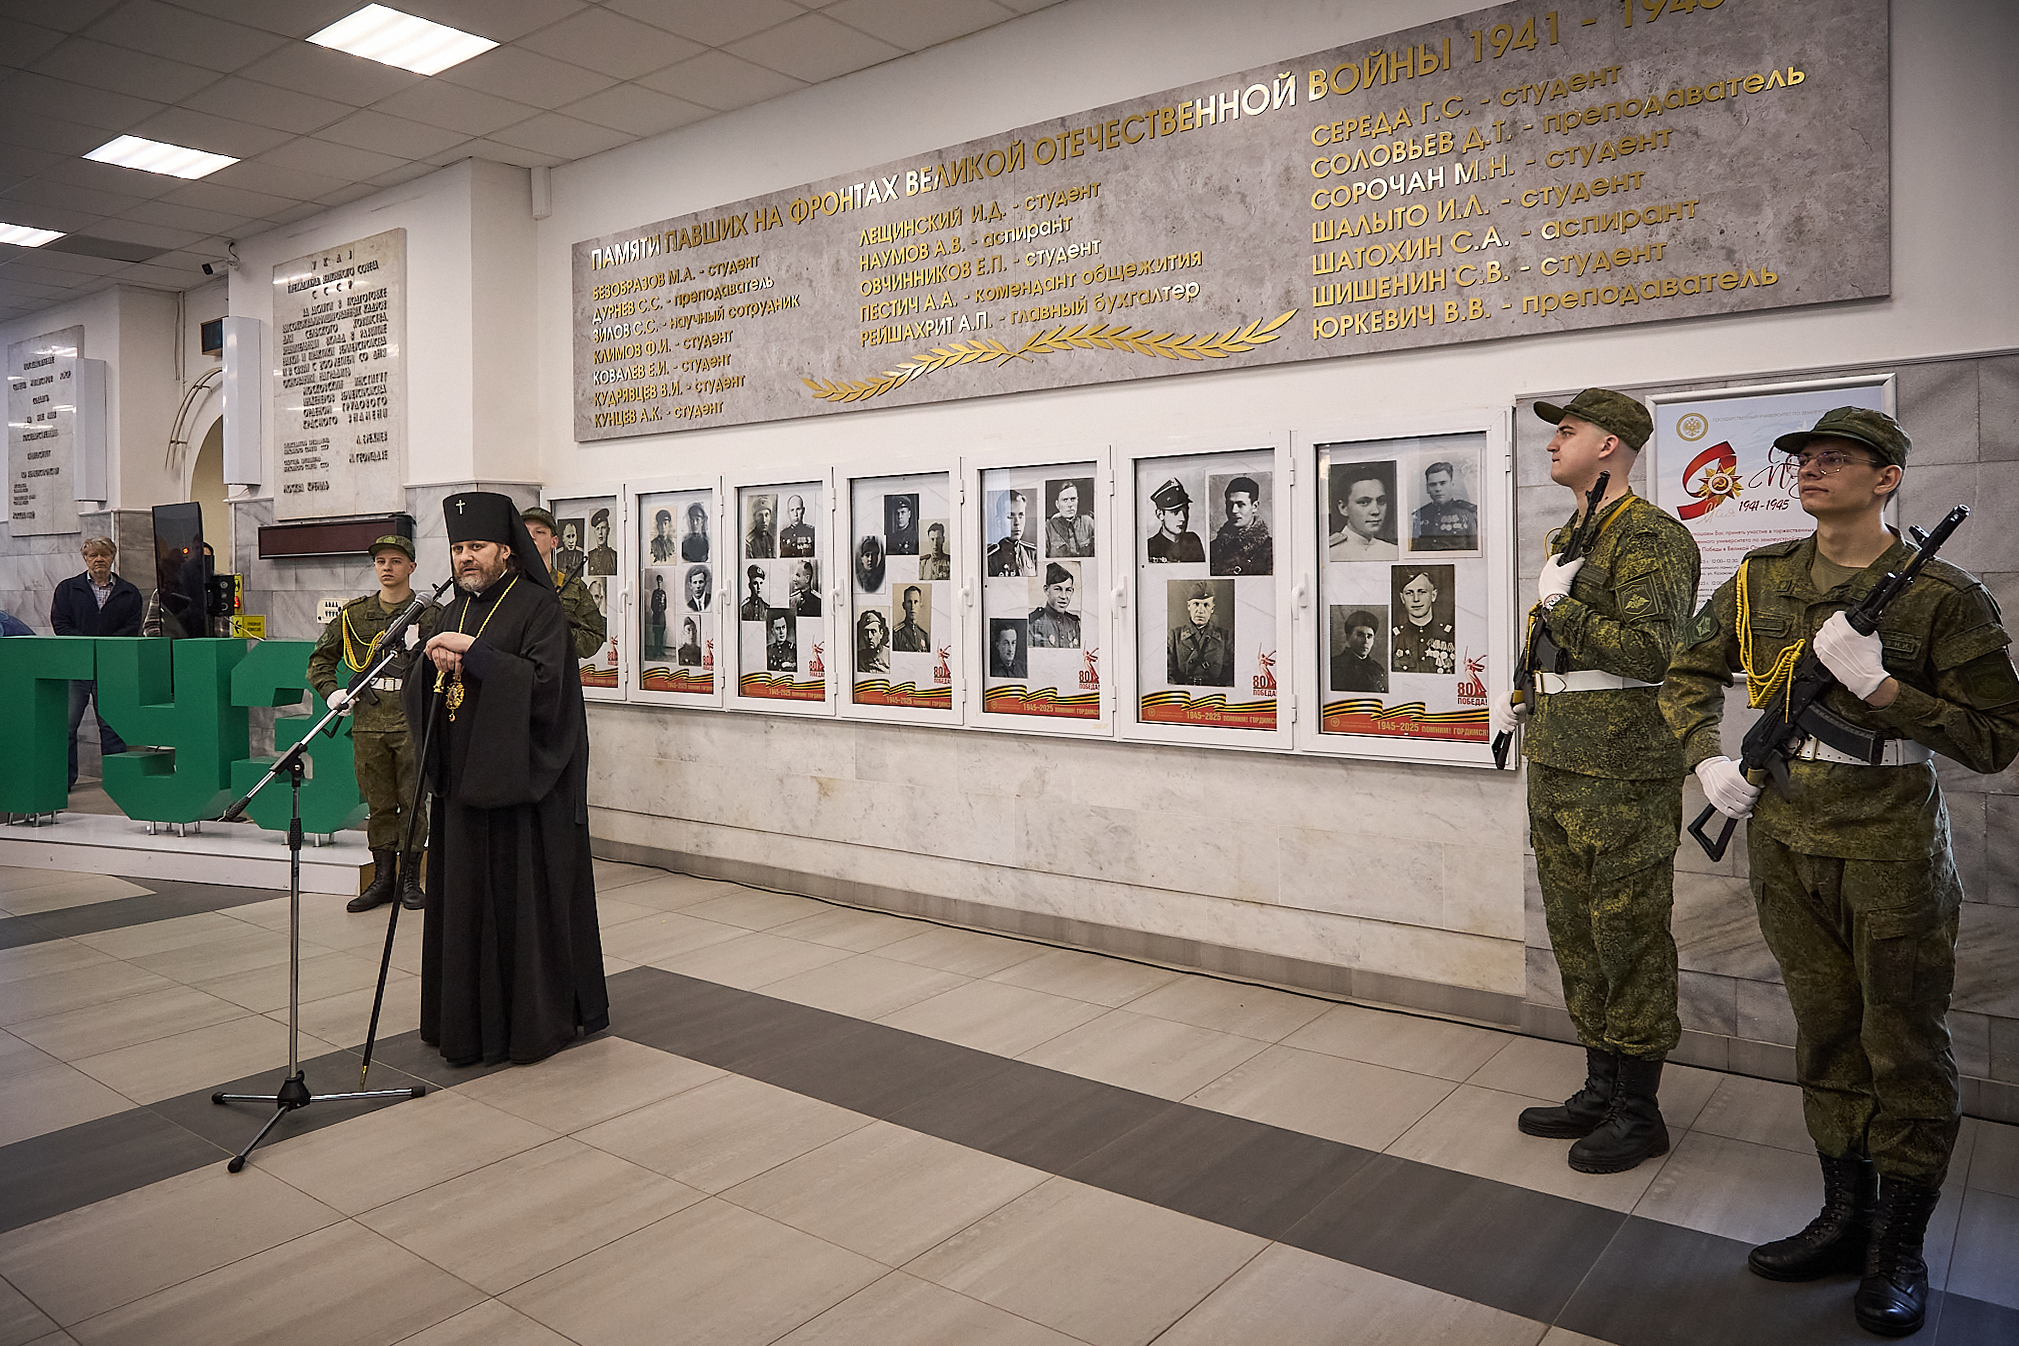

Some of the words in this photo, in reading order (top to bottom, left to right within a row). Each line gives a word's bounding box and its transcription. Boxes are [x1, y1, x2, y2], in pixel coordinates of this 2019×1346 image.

[1311, 111, 1412, 147] СЕРЕДА
[1421, 96, 1471, 124] Г.С.
[1500, 65, 1621, 107] студент
[1311, 131, 1454, 179] СОЛОВЬЕВ
[1544, 67, 1805, 135] преподаватель
[591, 234, 661, 270] ПАМЯТИ
[665, 213, 748, 253] ПАВШИХ
[753, 206, 783, 233] НА
[788, 175, 899, 225] ФРОНТАХ
[905, 139, 1026, 196] ВЕЛИКОЙ
[1032, 71, 1297, 166] ОТЕЧЕСТВЕННОЙ
[1308, 38, 1451, 102] ВОЙНЫ
[1470, 11, 1559, 63] 1941
[1311, 166, 1444, 211] СОРОЧАН
[1454, 154, 1514, 187] М.Н.
[1546, 129, 1673, 168] студент
[859, 206, 962, 247] ЛЕЩИНСКИЙ
[971, 202, 1006, 223] И.Д.
[1024, 182, 1101, 212] студент
[1312, 205, 1428, 244] ШАЛЫТО
[1438, 194, 1489, 222] И.Л.
[1520, 170, 1645, 208] студент
[860, 242, 929, 272] НАУМОВ
[934, 236, 965, 259] А.В.
[983, 214, 1073, 249] аспирант
[1312, 235, 1442, 276] ШАТОХИН
[1451, 226, 1510, 254] С.А.
[1541, 199, 1699, 240] аспирант
[592, 273, 665, 301] БЕЗОБРАЗОВ
[668, 267, 696, 286] М.А.
[708, 254, 760, 278] студент
[859, 263, 970, 296] ОВЧИННИКОВ
[976, 255, 1007, 276] Е.П.
[1025, 238, 1101, 267] студент
[860, 293, 919, 322] ПЕСТИЧ
[924, 289, 958, 311] А.А.
[975, 271, 1076, 303] комендант
[1081, 250, 1202, 287] общежития
[1312, 268, 1446, 308] ШИШЕНИН
[1456, 261, 1509, 288] С.В.
[1540, 242, 1667, 276] студент
[592, 301, 635, 326] ДУРНЕВ
[638, 296, 663, 314] С.С.
[674, 276, 774, 308] преподаватель
[593, 322, 631, 344] ЗИЛОВ
[634, 319, 658, 336] С.С.
[670, 309, 724, 330] научный
[728, 294, 800, 320] сотрудник
[860, 314, 954, 348] РЕЙШАХРИТ
[959, 309, 993, 332] А.П.
[1010, 295, 1088, 326] главный
[1093, 279, 1200, 313] бухгалтер
[1313, 304, 1434, 340] ЮРКЕВИЧ
[1444, 298, 1491, 324] В.В.
[1522, 266, 1779, 316] преподаватель
[593, 342, 642, 365] КЛИМОВ
[644, 338, 671, 356] Ф.И.
[682, 330, 733, 352] студент
[593, 364, 645, 385] КОВАЛЕВ
[648, 360, 670, 377] Е.И.
[681, 353, 732, 375] студент
[594, 380, 657, 408] КУДРЯВЦЕВ
[660, 380, 682, 398] В.И.
[694, 374, 746, 396] студент
[594, 406, 636, 428] КУНЦЕВ
[640, 403, 662, 421] А.К.
[674, 400, 724, 420] студент
[1739, 499, 1790, 511] 1941-1945
[1079, 671, 1090, 682] 80
[1253, 675, 1266, 687] 80
[1458, 682, 1474, 696] 80
[1458, 697, 1488, 706] ПОБЕДА!
[1186, 711, 1221, 720] 1945-2025
[1377, 721, 1419, 732] 1945-2025
[1422, 726, 1451, 734] ПОМНИМ!
